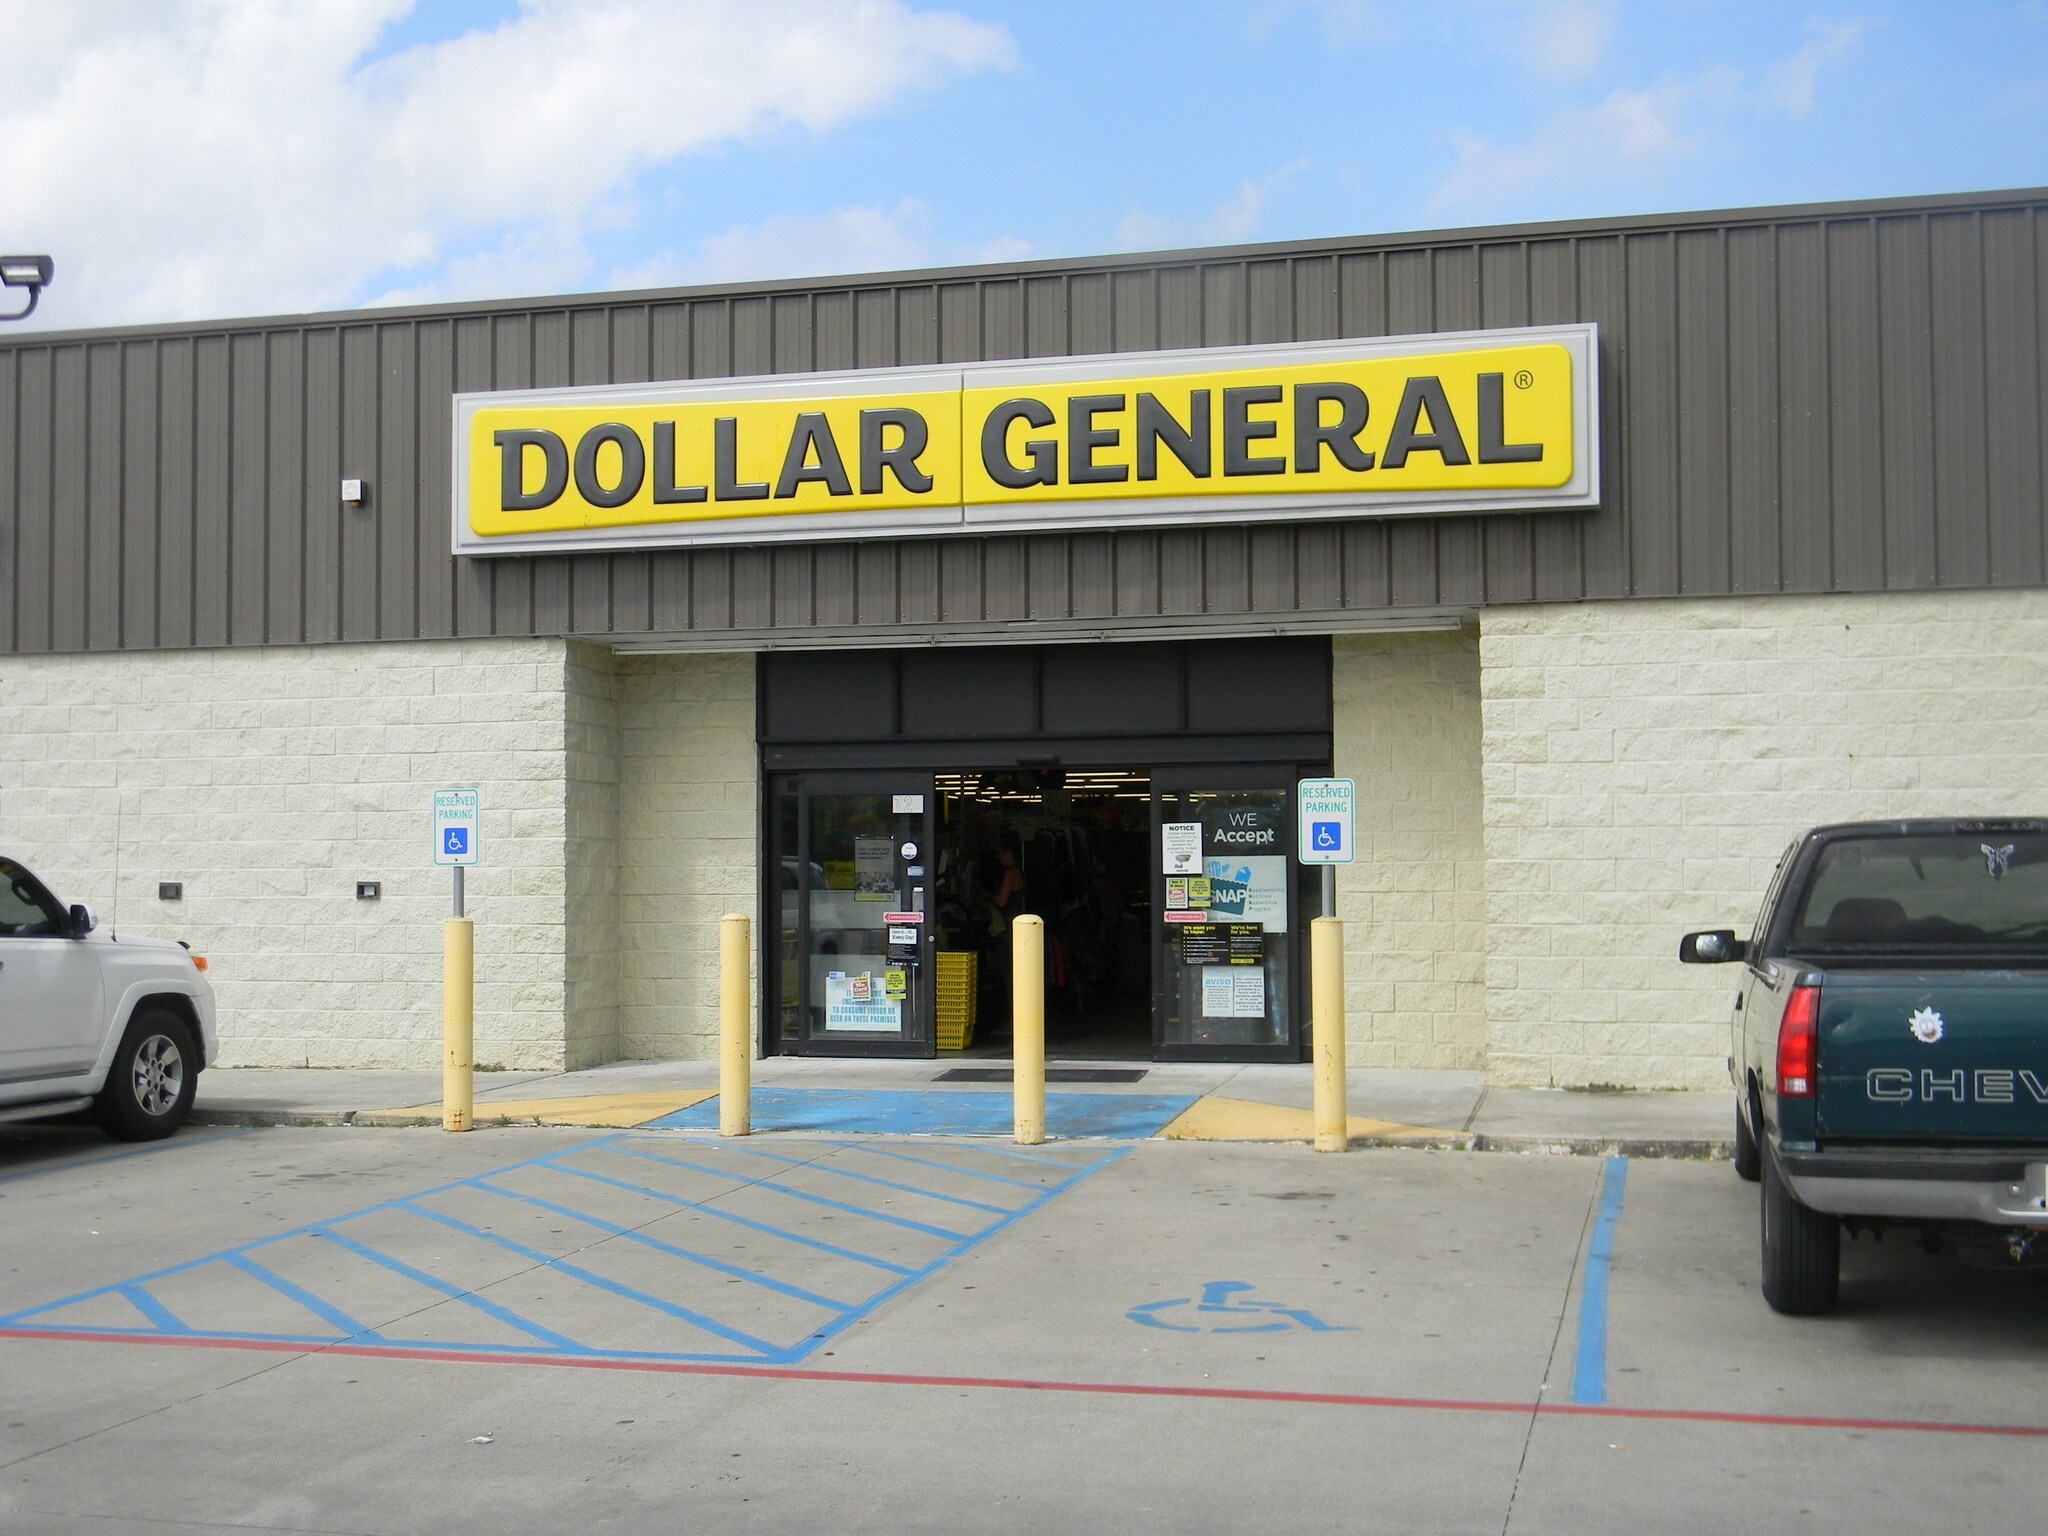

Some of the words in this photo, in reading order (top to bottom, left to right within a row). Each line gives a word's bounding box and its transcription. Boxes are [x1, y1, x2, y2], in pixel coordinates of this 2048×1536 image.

[494, 407, 934, 512] DOLLAR
[980, 372, 1545, 489] GENERAL
[1302, 787, 1350, 799] RESERVED
[436, 796, 475, 806] RESERVED
[1305, 801, 1347, 813] PARKING
[439, 810, 473, 819] PARKING
[1228, 812, 1257, 827] WE
[1213, 828, 1275, 845] Accept
[832, 1006, 840, 1014] TO
[841, 1006, 867, 1014] CONSUME
[867, 1007, 887, 1015] LIQUOR
[888, 1007, 896, 1015] OR
[844, 1015, 852, 1023] ON
[853, 1015, 869, 1023] THESE
[870, 1016, 897, 1024] PREMISES
